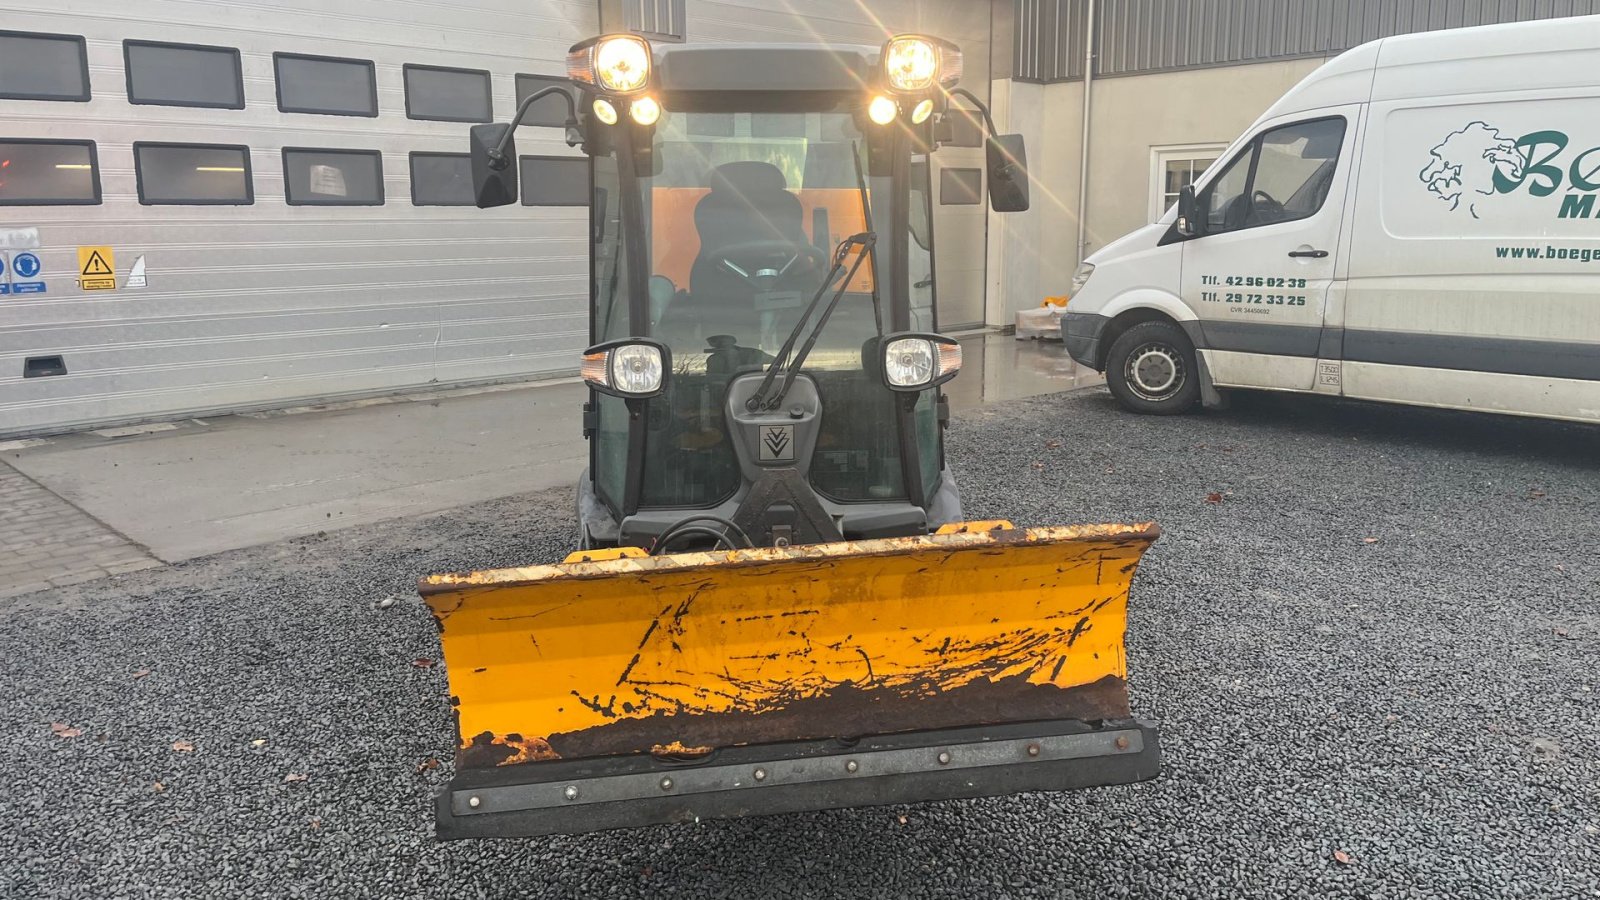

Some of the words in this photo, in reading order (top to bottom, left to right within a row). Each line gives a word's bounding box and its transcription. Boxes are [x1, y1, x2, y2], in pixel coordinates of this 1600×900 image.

[1557, 194, 1600, 219] M
[1496, 245, 1600, 263] www.boege
[1202, 275, 1220, 285] Tlf.
[1225, 276, 1243, 286] 42
[1246, 277, 1263, 287] 96
[1266, 277, 1284, 288] 02
[1287, 278, 1306, 288] 38
[1201, 292, 1220, 302] Tlf.
[1225, 293, 1242, 303] 29
[1246, 294, 1262, 304] 72
[1266, 295, 1284, 305] 33
[1287, 296, 1305, 306] 25
